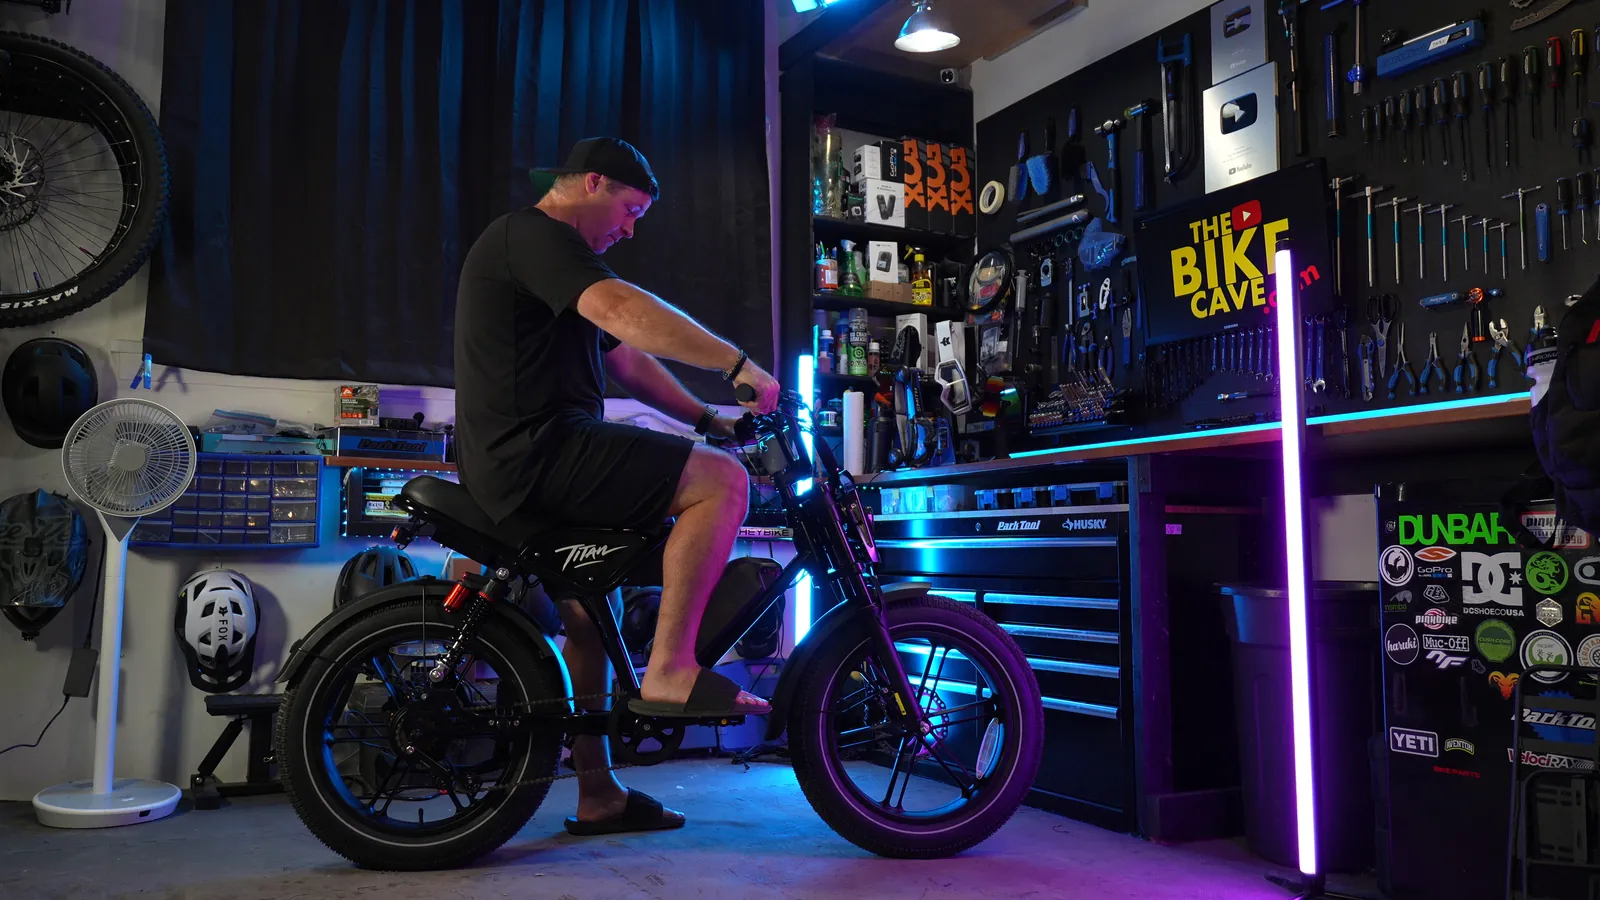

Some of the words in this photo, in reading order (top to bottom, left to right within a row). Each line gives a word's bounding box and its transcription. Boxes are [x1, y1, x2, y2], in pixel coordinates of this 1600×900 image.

[1189, 211, 1232, 244] THE
[0, 286, 79, 309] MAXXIS
[1190, 276, 1267, 319] CAVE
[1073, 519, 1108, 530] HUSKY
[218, 619, 228, 641] FOX
[1387, 637, 1418, 652] haruki
[1424, 636, 1467, 650] Muc-Off
[1393, 732, 1434, 752] YETI
